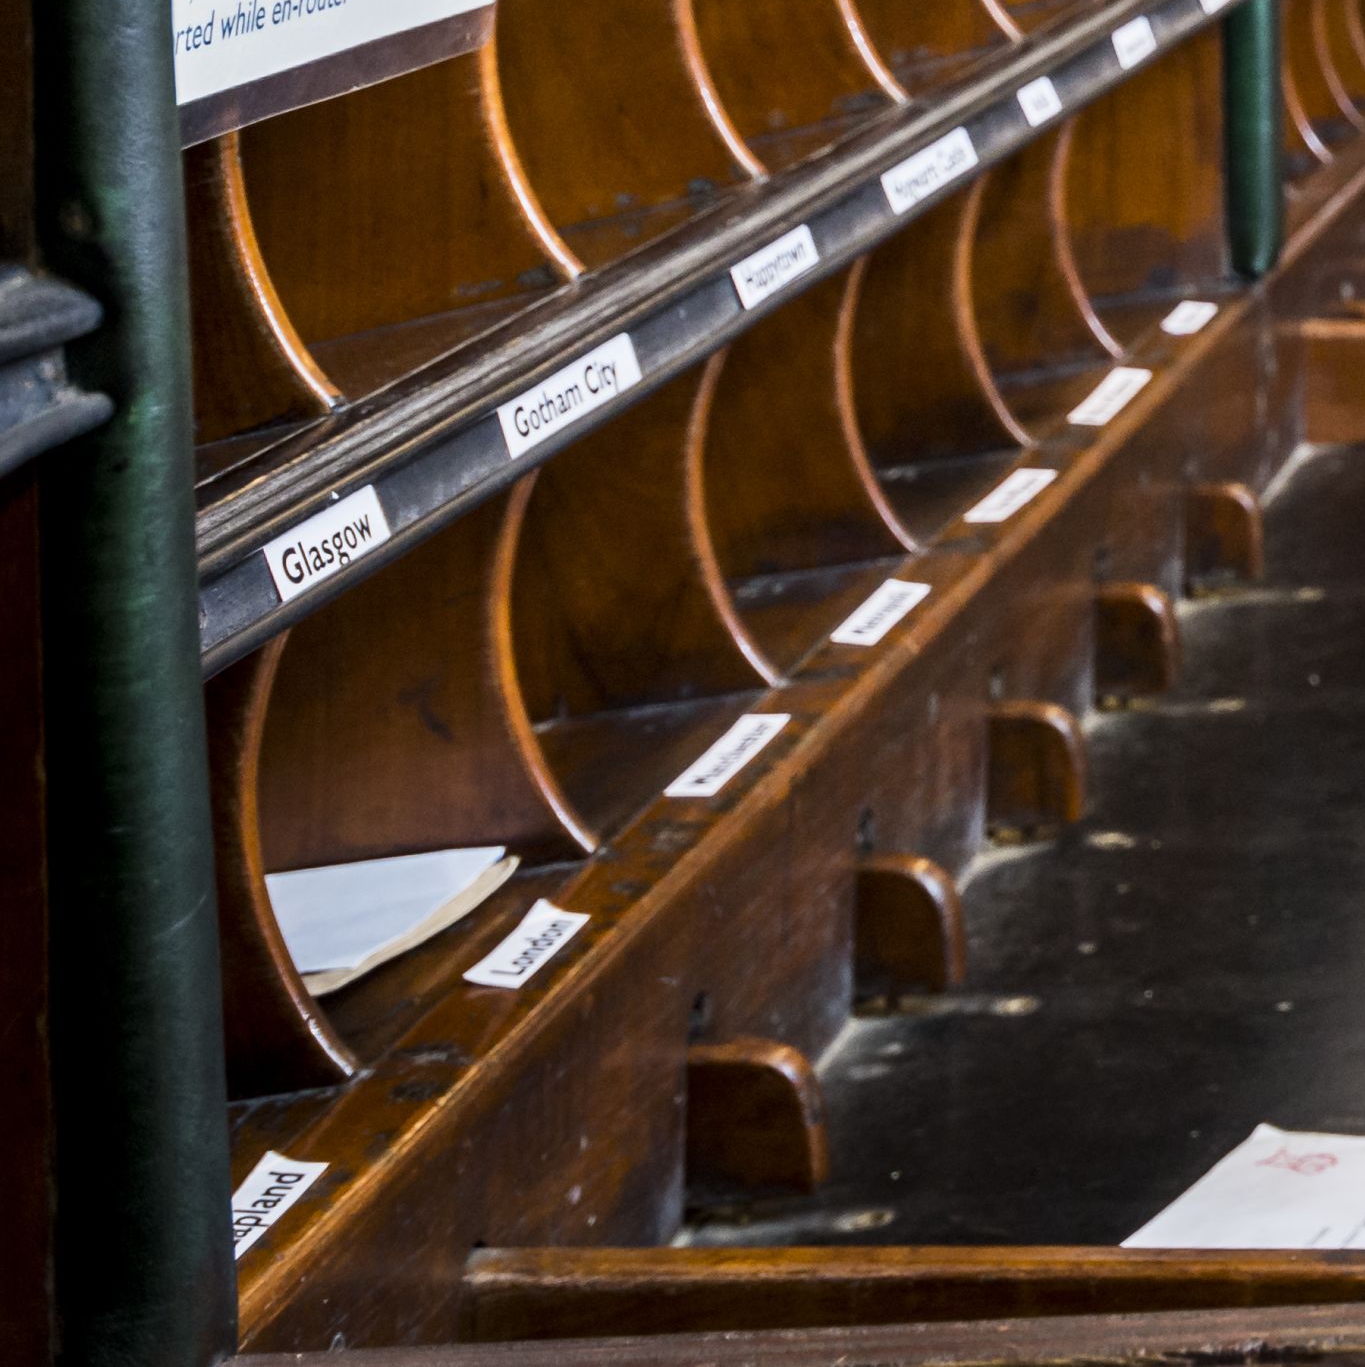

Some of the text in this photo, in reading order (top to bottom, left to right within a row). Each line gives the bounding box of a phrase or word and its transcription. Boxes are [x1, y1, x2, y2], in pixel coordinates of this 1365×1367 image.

[513, 358, 618, 437] Gotham City
[282, 514, 372, 584] Glasgow
[489, 920, 575, 975] London
[233, 1171, 306, 1246] apland
